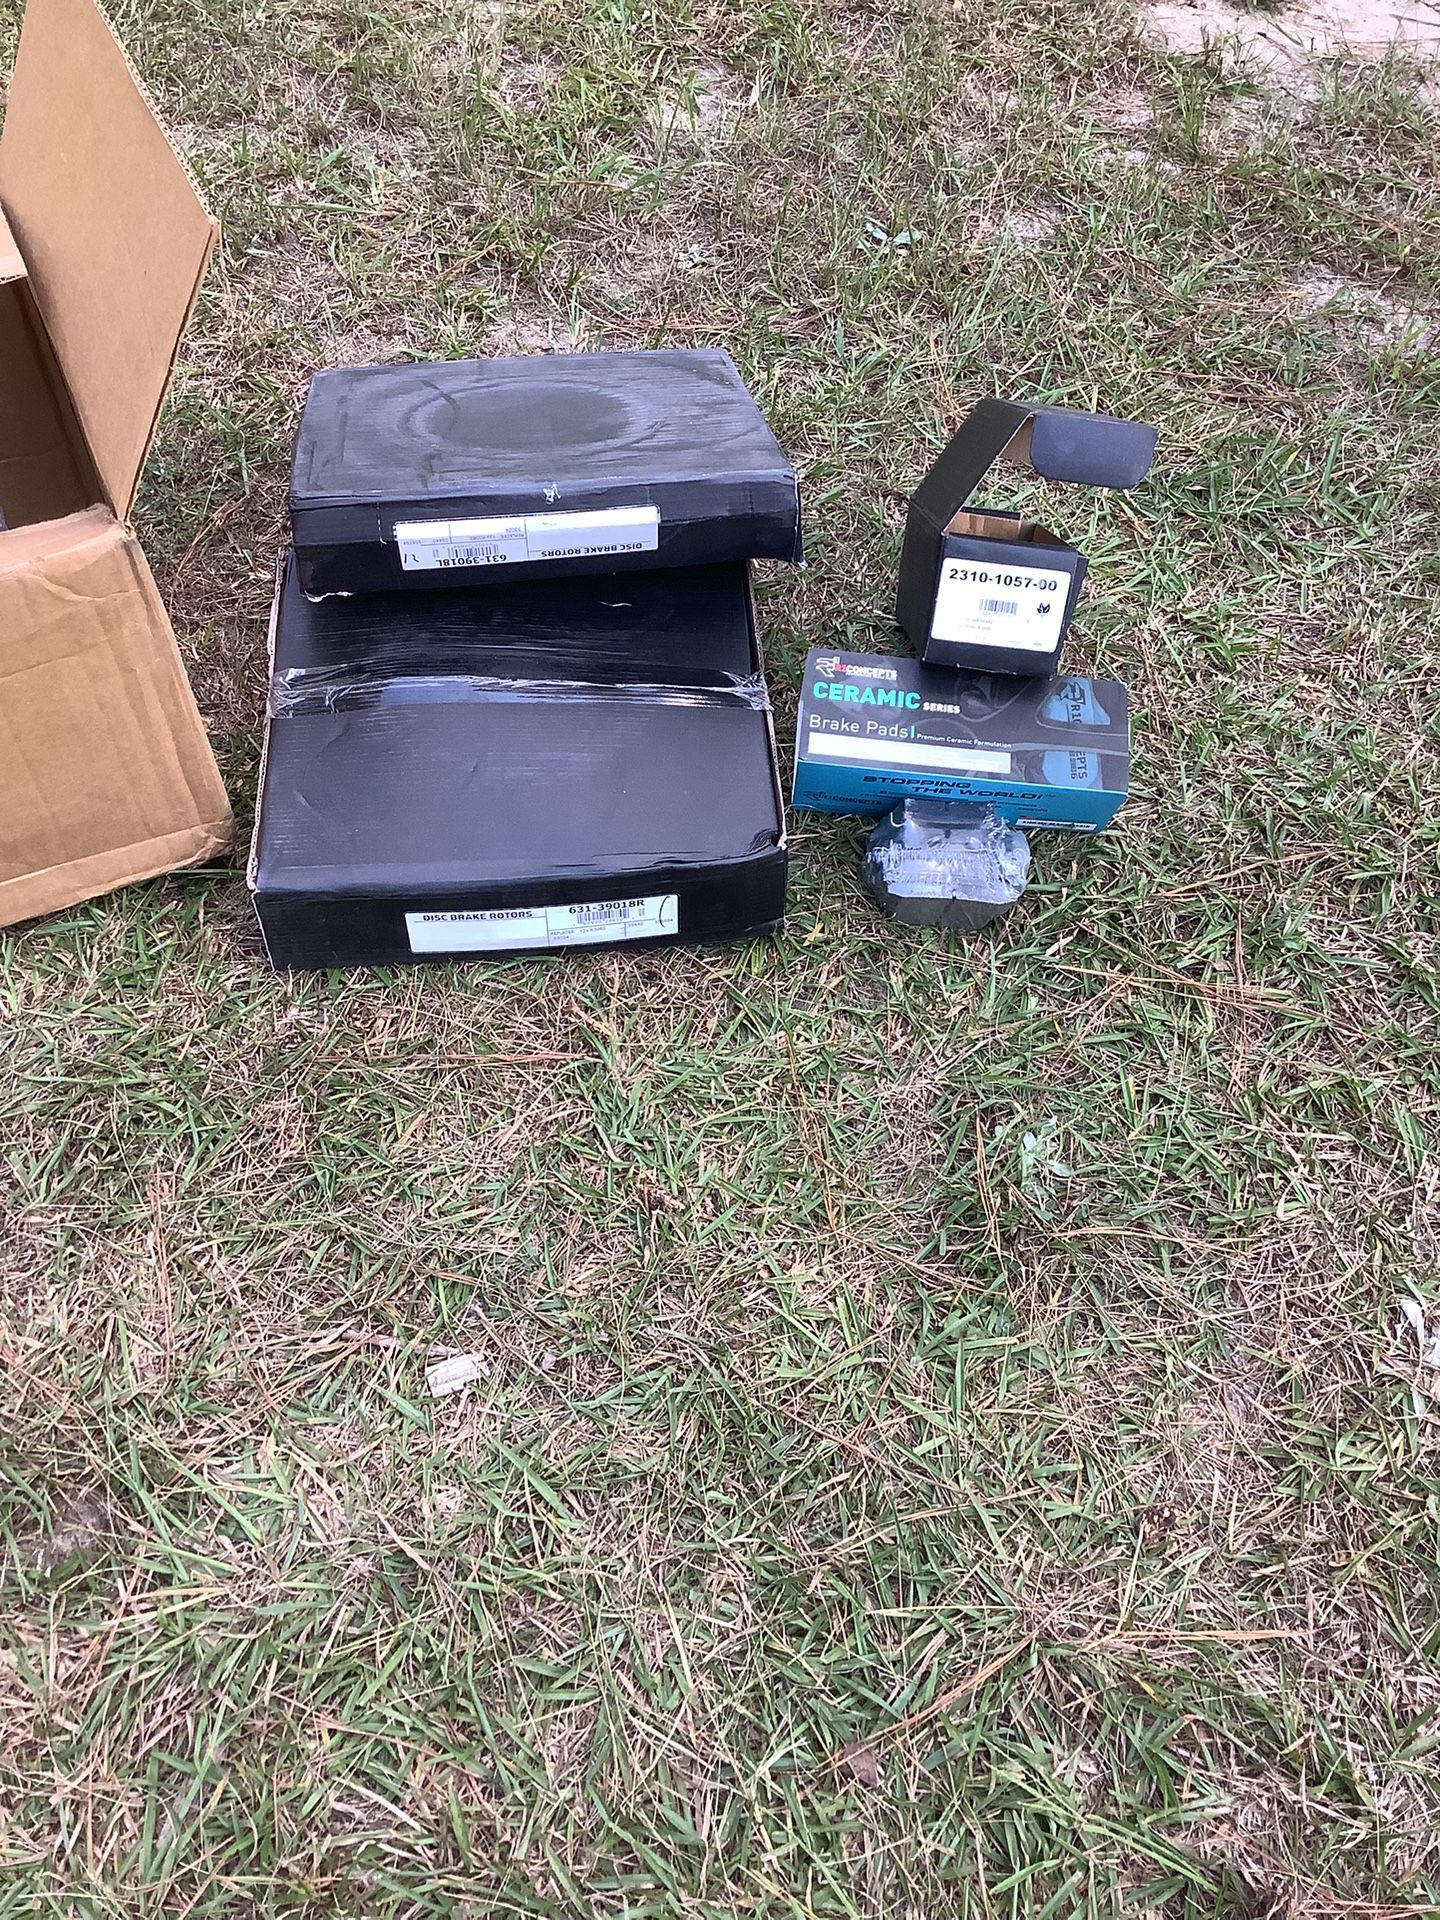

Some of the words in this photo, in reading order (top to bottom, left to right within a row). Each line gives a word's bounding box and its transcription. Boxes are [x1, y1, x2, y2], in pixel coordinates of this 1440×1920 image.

[540, 547, 580, 557] ROTORS
[583, 544, 618, 553] BRAKE
[623, 541, 643, 551] DISC
[435, 554, 507, 567] 631-39018L
[949, 568, 1058, 592] 2310-1057-00
[813, 681, 922, 710] CERAMIC
[923, 702, 961, 714] SERIES
[809, 714, 860, 733] Brake
[866, 717, 909, 738] Pads
[916, 733, 946, 743] Premium
[946, 736, 973, 745] Ceramic
[974, 739, 1012, 749] Formulation
[862, 775, 971, 789] STOPPING
[912, 786, 963, 796] THE
[966, 788, 1043, 799] WORLD!
[568, 899, 645, 914] 631-39018R
[423, 914, 448, 922] DISC
[450, 913, 487, 921] BRAKE
[489, 910, 533, 920] ROTORS
